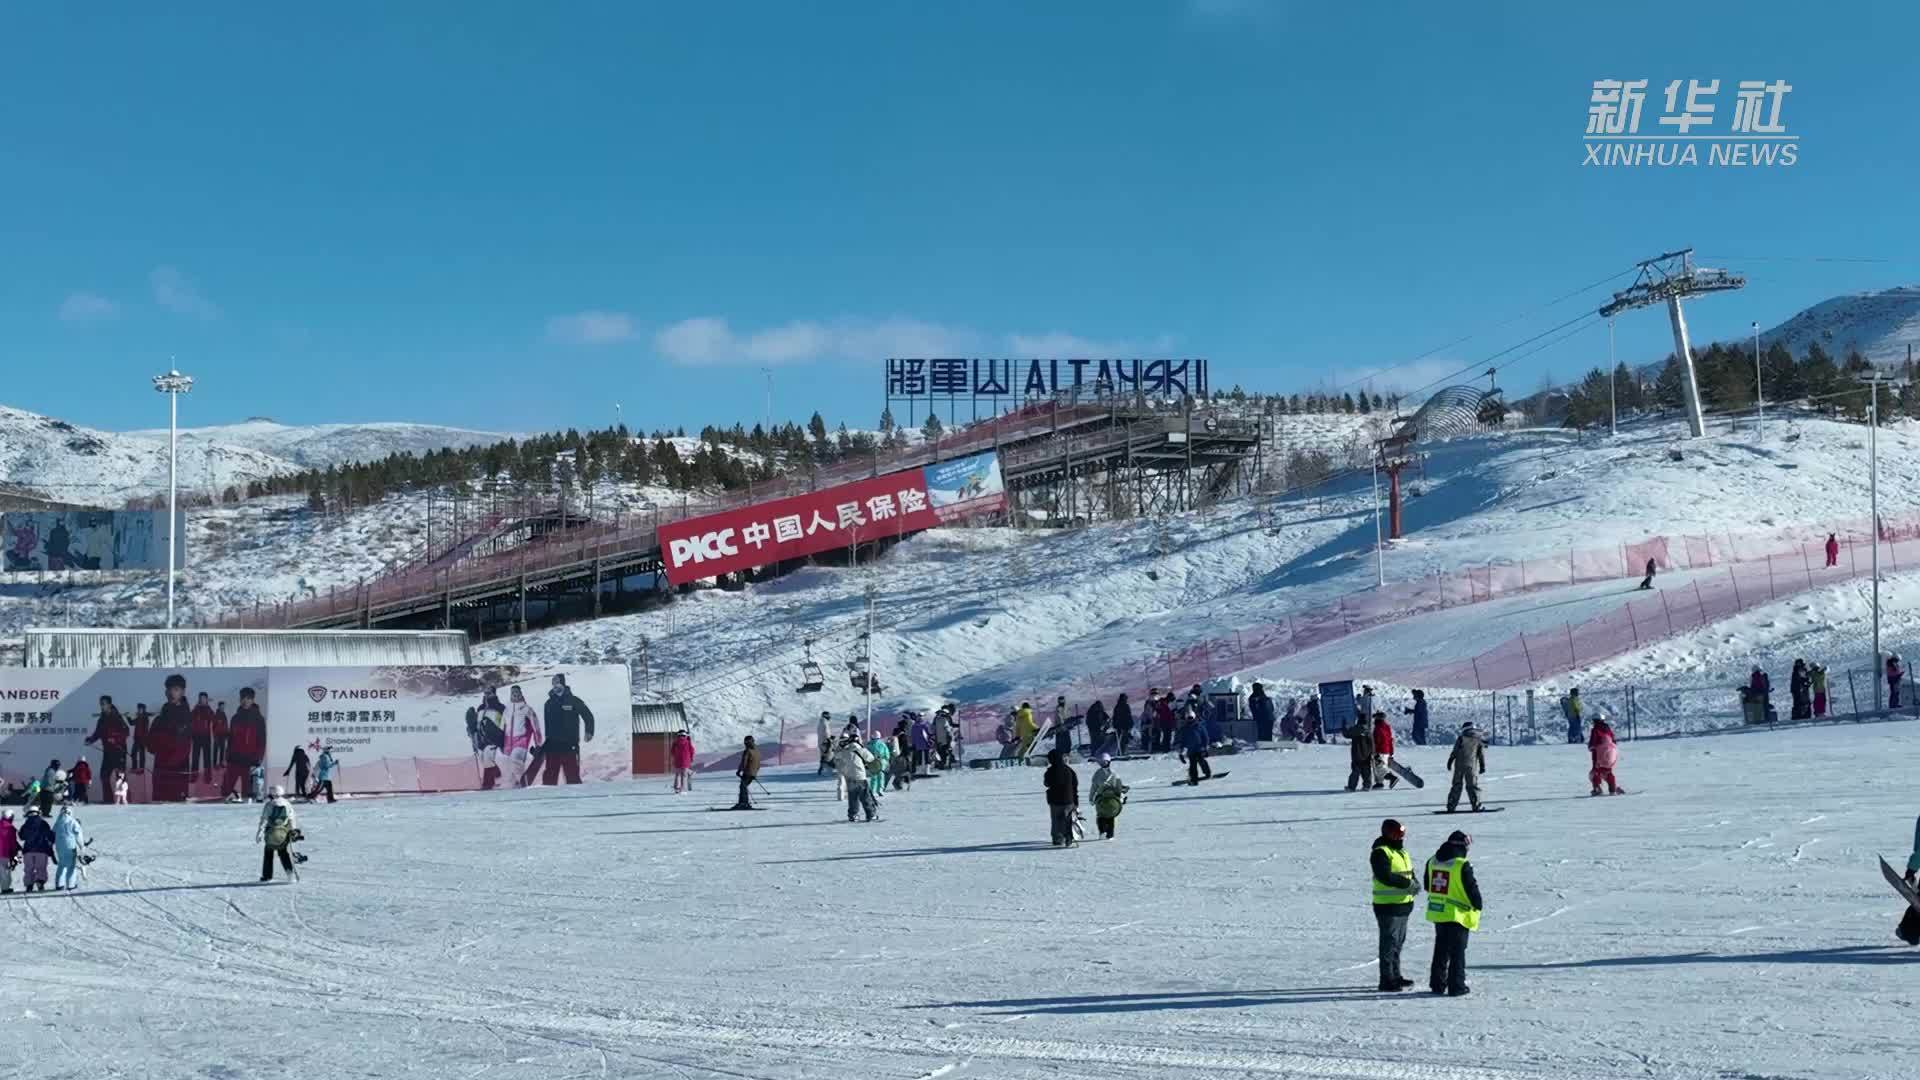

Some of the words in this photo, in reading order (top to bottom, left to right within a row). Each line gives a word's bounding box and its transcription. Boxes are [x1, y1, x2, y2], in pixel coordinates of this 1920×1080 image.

[742, 487, 927, 551] 中国人民保险
[669, 527, 738, 568] PICC
[331, 689, 398, 700] TANBOER
[0, 711, 53, 724] 滑雪系列
[307, 710, 396, 723] 坦博尔滑雪系列
[326, 737, 371, 745] Snowboard
